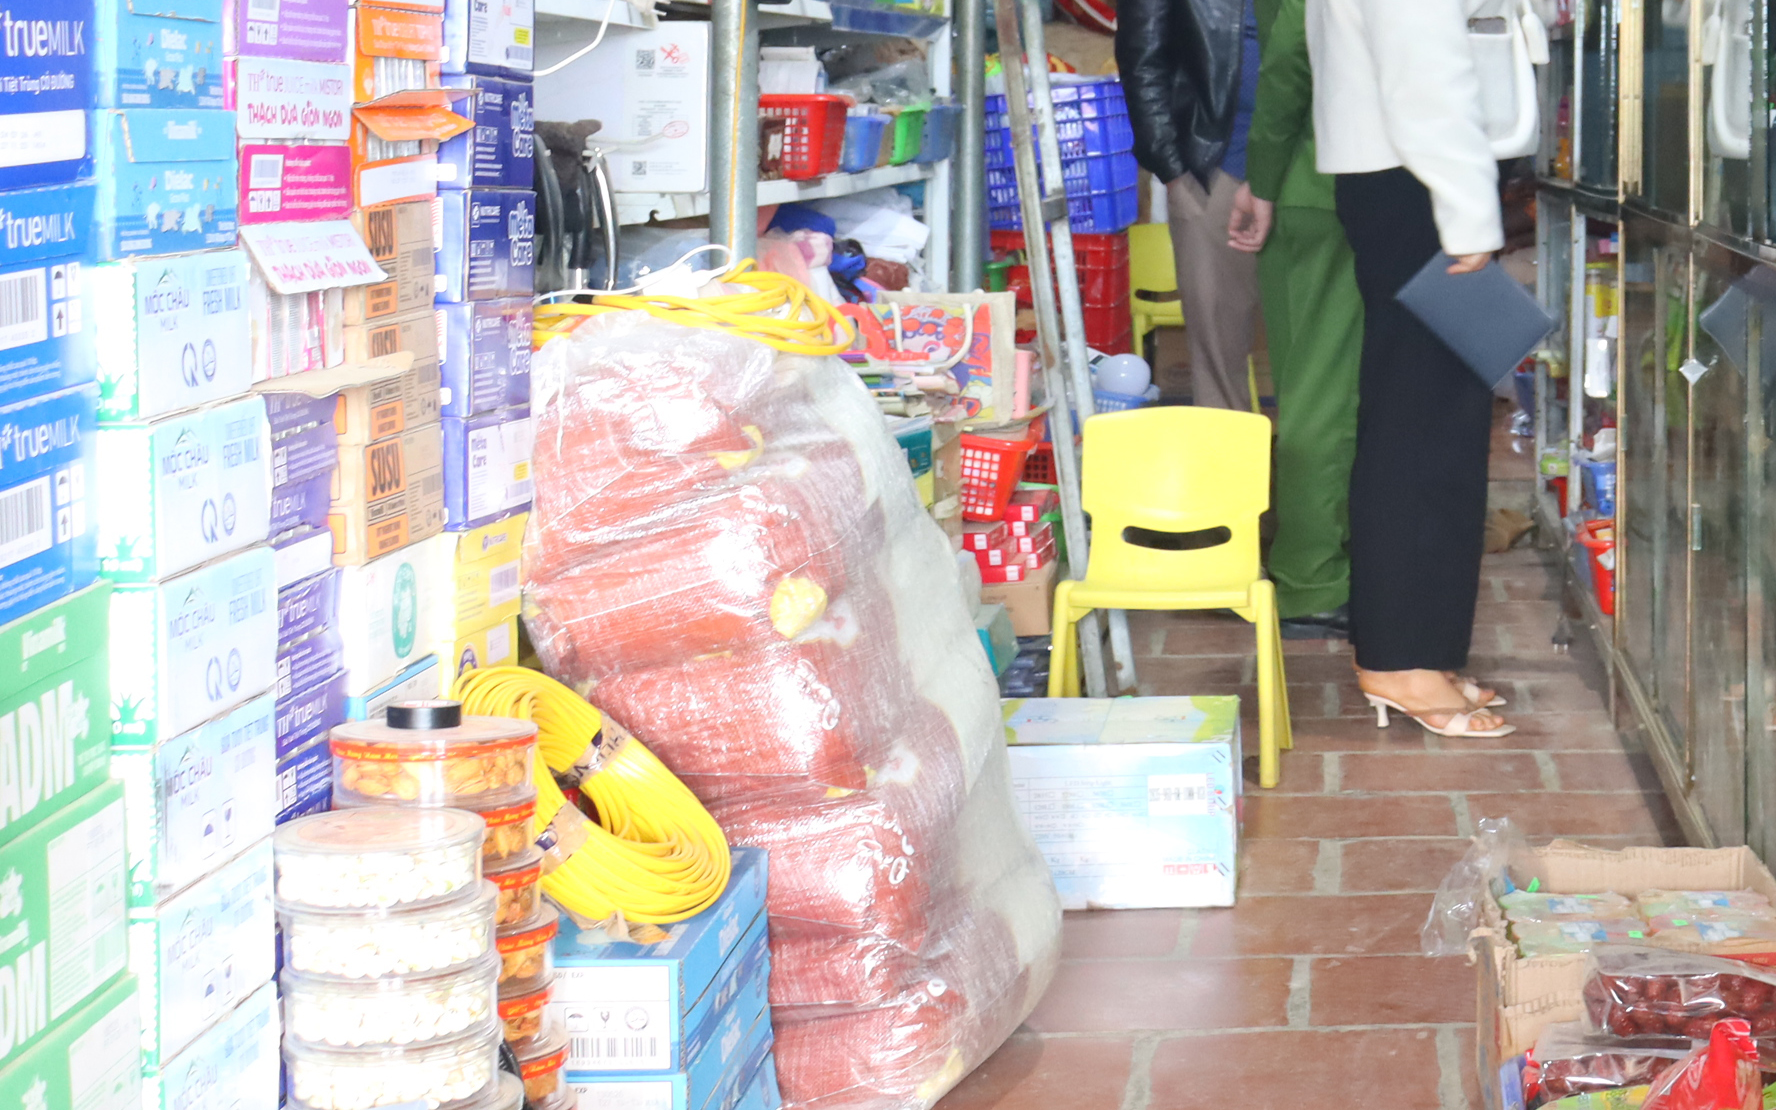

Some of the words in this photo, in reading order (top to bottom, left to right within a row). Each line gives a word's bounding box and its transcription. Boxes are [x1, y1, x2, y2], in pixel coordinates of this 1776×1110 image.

[247, 102, 278, 129] THẠCH
[322, 105, 344, 130] NGON
[144, 289, 167, 317] MỘC
[167, 286, 191, 311] CHÂU
[162, 455, 184, 478] MỘC
[185, 443, 210, 471] CHÂU
[371, 441, 401, 498] SUSU
